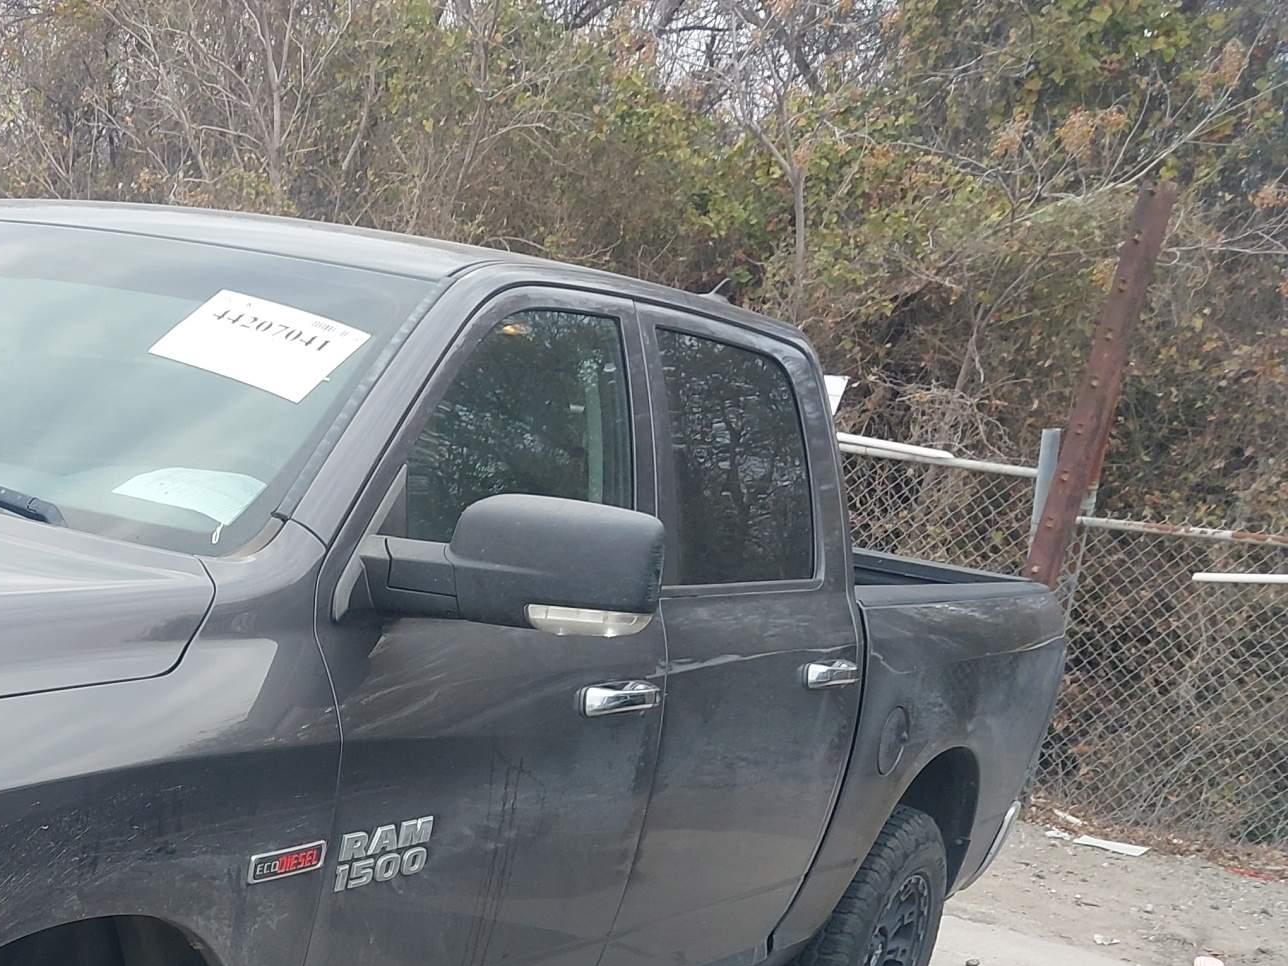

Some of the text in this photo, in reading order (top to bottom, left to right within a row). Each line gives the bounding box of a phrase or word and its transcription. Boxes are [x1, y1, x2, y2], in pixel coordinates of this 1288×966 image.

[212, 308, 331, 352] 44207041
[338, 815, 434, 862] RAM
[255, 849, 318, 876] ECODIESEL
[334, 846, 427, 893] 1500
